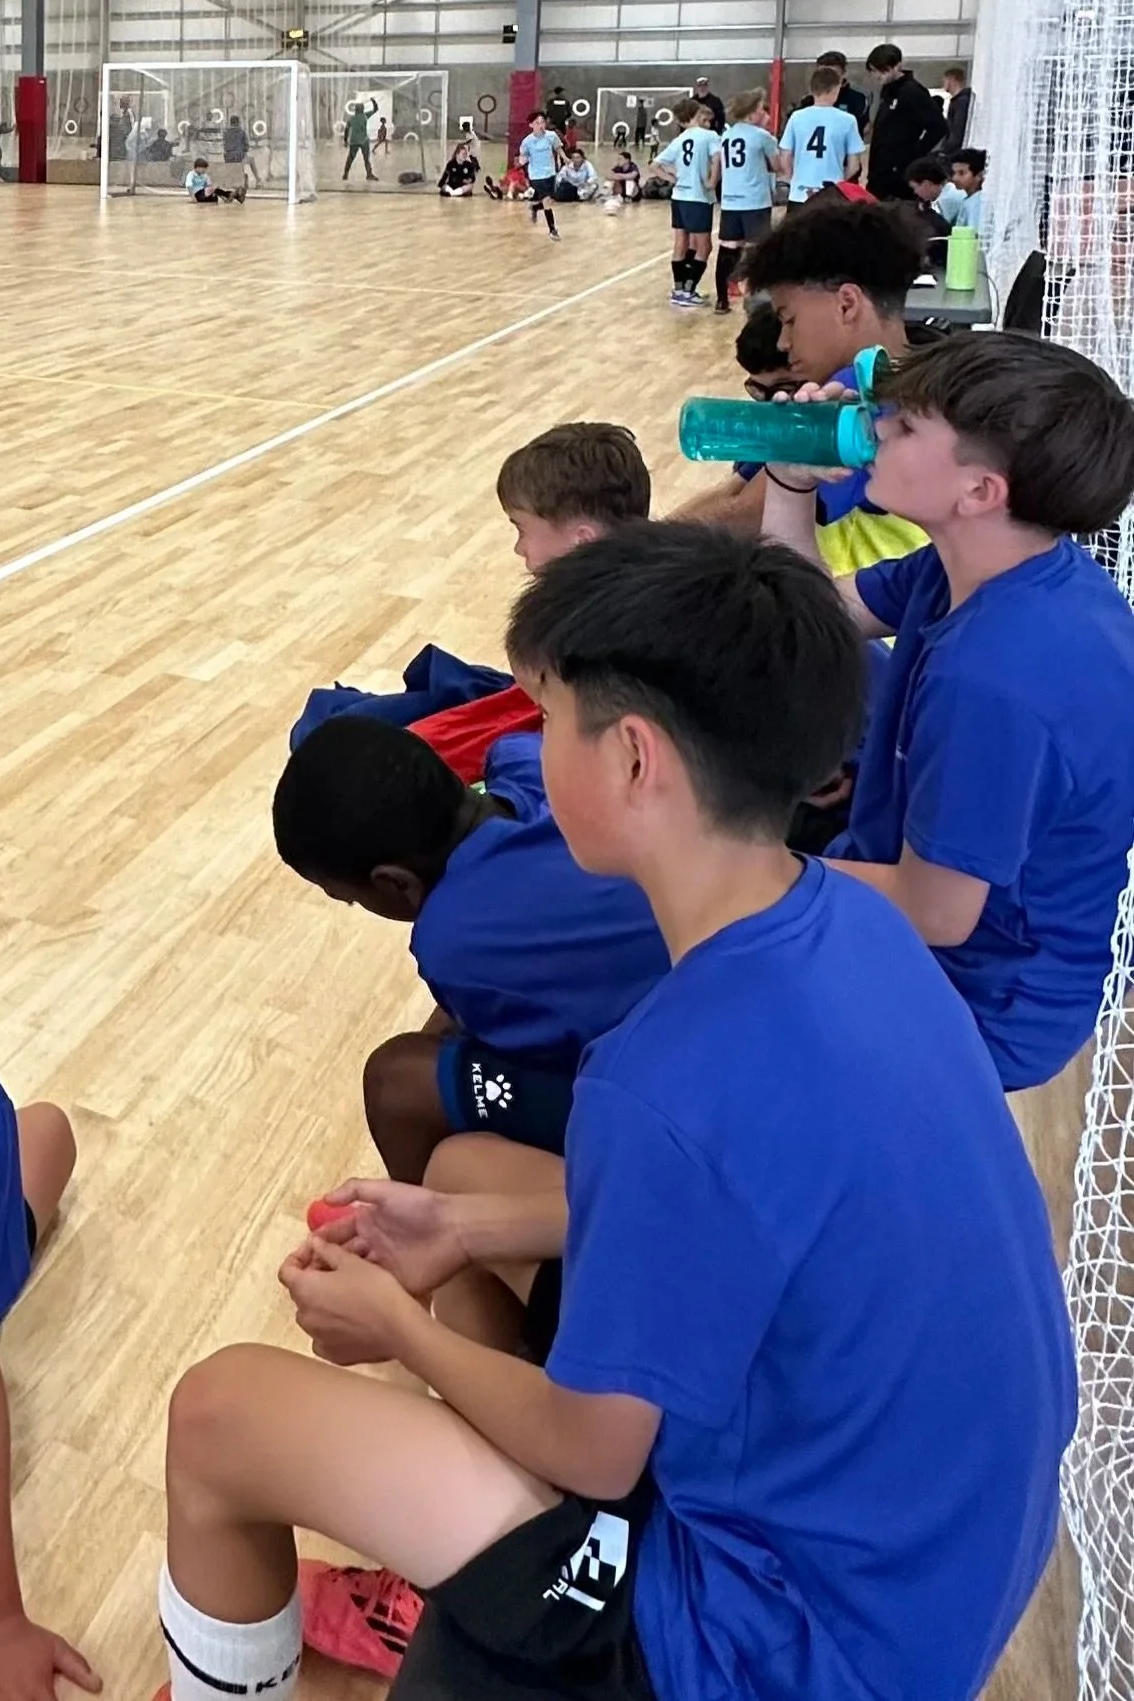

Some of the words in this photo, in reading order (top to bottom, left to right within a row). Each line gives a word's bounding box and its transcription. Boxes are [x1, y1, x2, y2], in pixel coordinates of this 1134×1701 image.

[682, 138, 694, 166] 8
[721, 137, 746, 168] 13
[806, 126, 827, 158] 4
[471, 1062, 489, 1119] KELME
